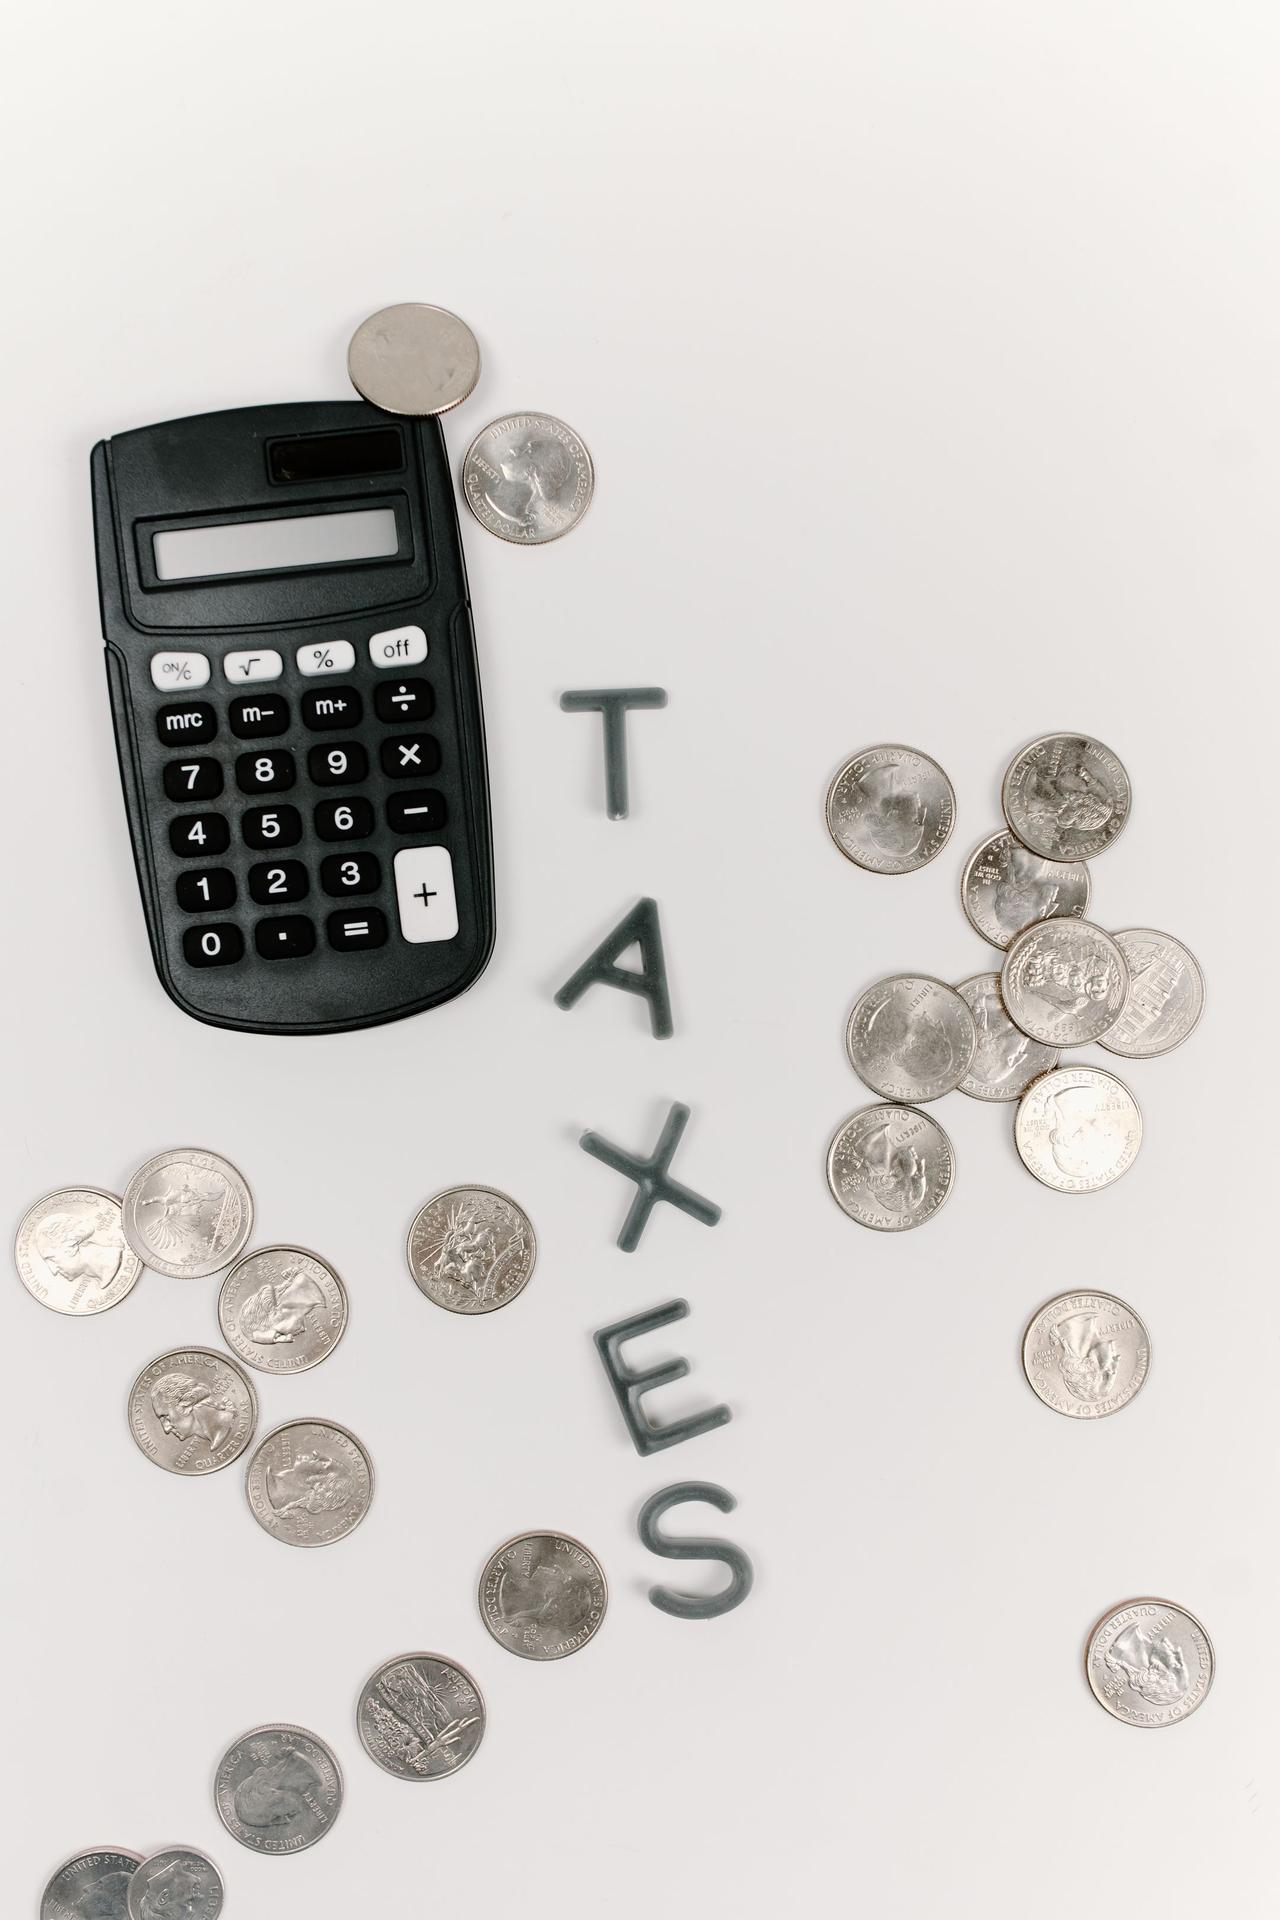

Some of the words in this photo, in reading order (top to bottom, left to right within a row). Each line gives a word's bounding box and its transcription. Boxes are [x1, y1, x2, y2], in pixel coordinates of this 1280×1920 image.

[383, 638, 411, 659] off
[315, 699, 347, 715] m+
[166, 712, 203, 731] mrc
[255, 758, 275, 782] 8
[327, 750, 347, 775] 9
[181, 765, 200, 790] 7
[261, 813, 281, 838] 5
[334, 806, 354, 830] 6
[187, 821, 207, 845] 4
[267, 869, 288, 894] 2
[340, 861, 361, 886] 3
[196, 877, 210, 901] 1
[201, 932, 221, 956] 0
[554, 687, 754, 1620] TAXES
[1036, 1303, 1069, 1334] DOLLAR
[1072, 1298, 1120, 1316] QUARTER
[1099, 1319, 1135, 1336] LIBERTY
[169, 1355, 220, 1370] AMERICA
[1131, 1347, 1147, 1389] UNITED
[133, 1377, 153, 1414] STATES
[1034, 1373, 1073, 1412] AMERICA
[1096, 1389, 1132, 1414] STATES
[134, 1418, 159, 1457] UNITED
[195, 1440, 240, 1470] QUARTER
[238, 1399, 249, 1439] DOLLAR
[176, 1436, 201, 1468] LIBERTY
[522, 1543, 533, 1578] LIBERTY
[554, 1541, 592, 1568] UNITED
[486, 1550, 517, 1593] QUARTER
[588, 1570, 603, 1608] STATES
[487, 1596, 509, 1636] DOLLAR
[1112, 1606, 1157, 1630] QUARTER
[1146, 1610, 1176, 1639] LIBERTY
[543, 1625, 590, 1654] AMERICA
[1092, 1631, 1112, 1669] DOLLAR
[1186, 1673, 1208, 1708] STATES
[1116, 1701, 1164, 1723] AMERICA
[281, 1733, 321, 1758] DOLLAR
[218, 1750, 245, 1795] AMERICA
[317, 1758, 337, 1807] QUARTER
[303, 1792, 328, 1823] LIBERTY
[230, 1817, 259, 1846] STATES
[264, 1834, 305, 1850] UNITED
[62, 1856, 101, 1881] UNITED
